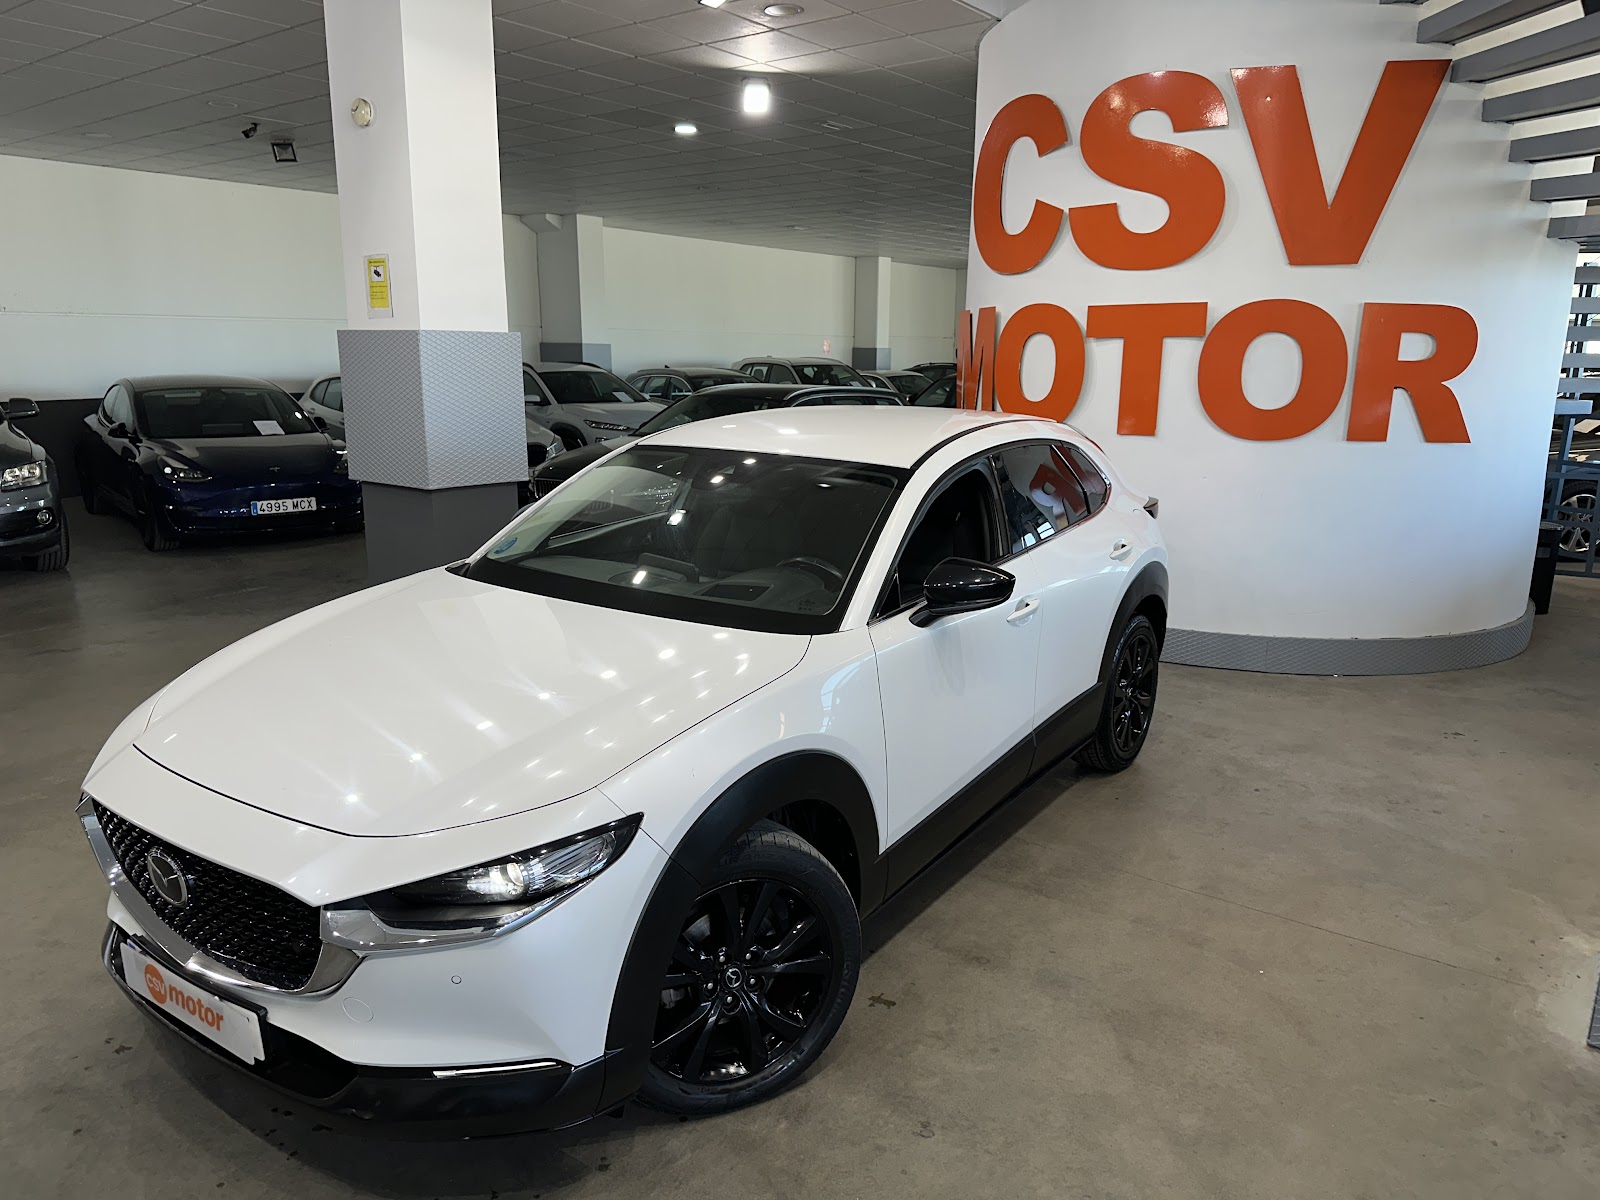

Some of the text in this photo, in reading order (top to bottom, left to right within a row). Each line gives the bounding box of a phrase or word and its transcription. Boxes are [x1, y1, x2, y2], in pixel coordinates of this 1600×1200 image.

[973, 59, 1452, 275] CSV
[956, 299, 1479, 443] MOTOR
[259, 499, 313, 512] 4995 MCX
[145, 974, 224, 1032] CSV motor
